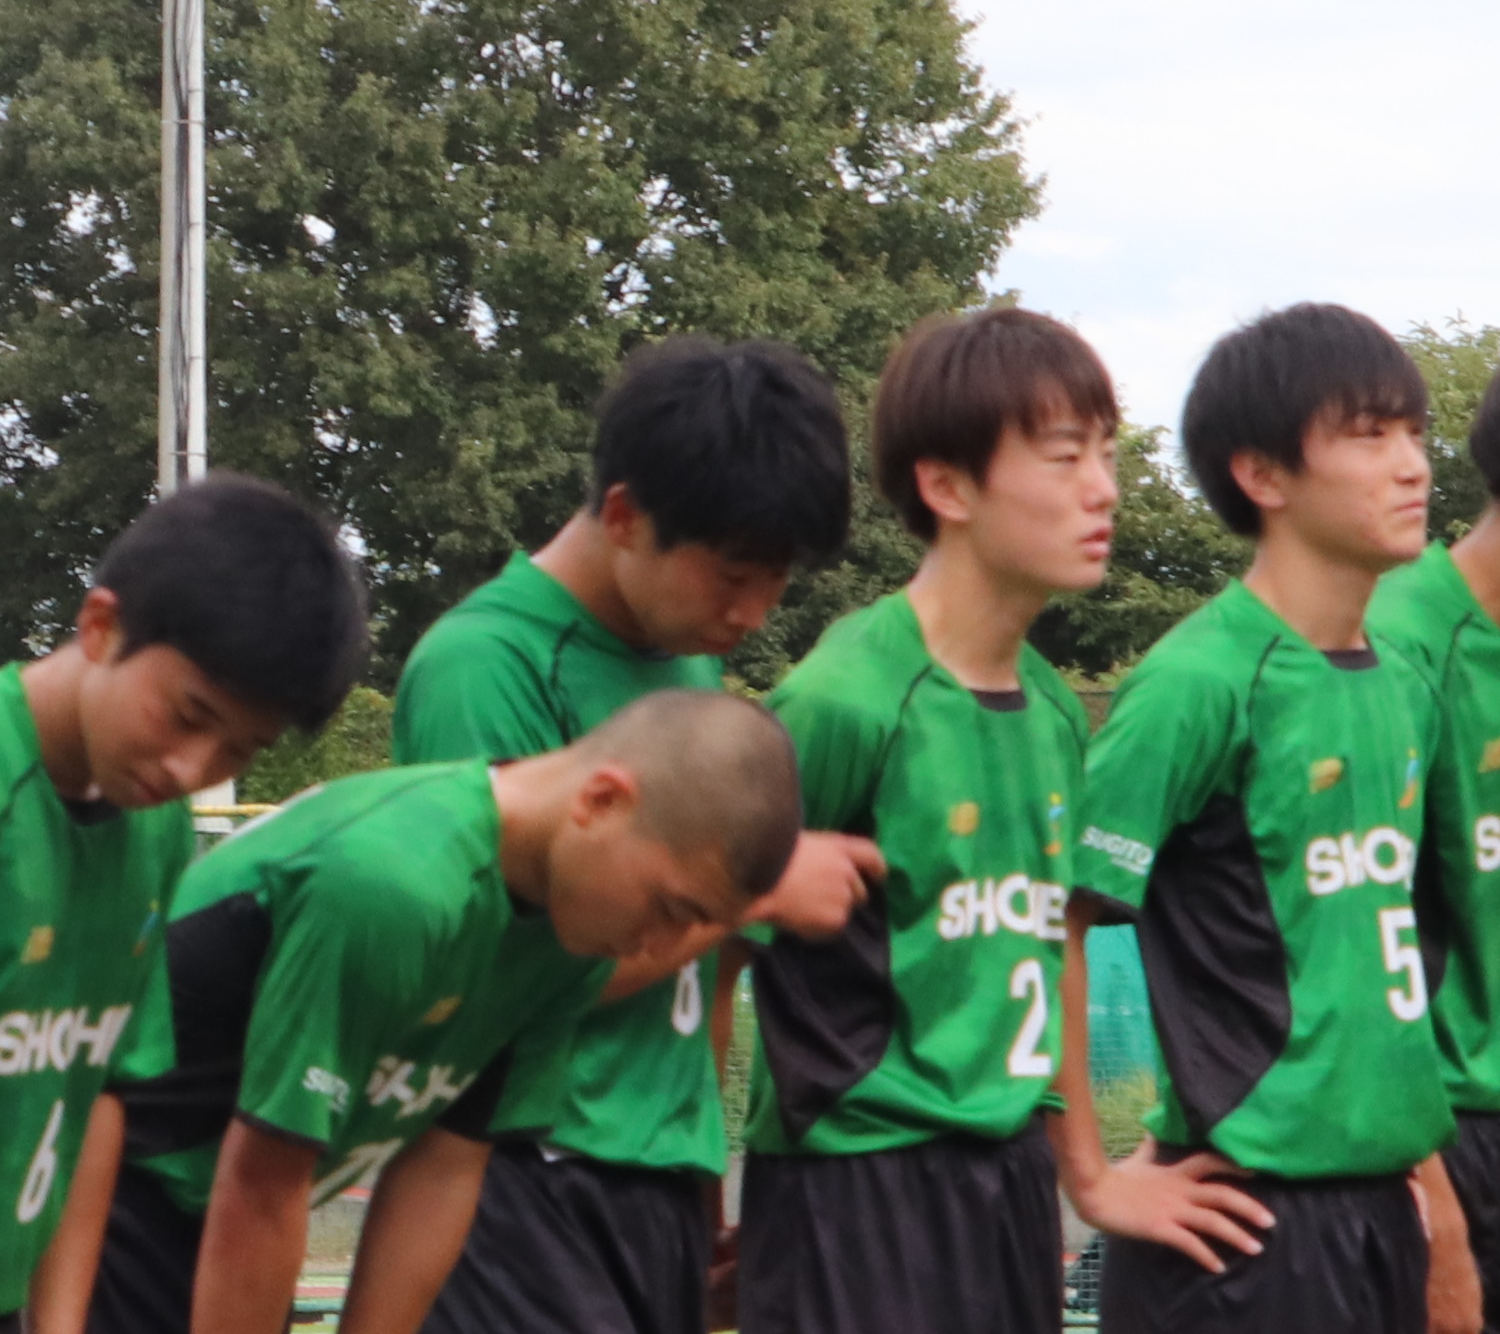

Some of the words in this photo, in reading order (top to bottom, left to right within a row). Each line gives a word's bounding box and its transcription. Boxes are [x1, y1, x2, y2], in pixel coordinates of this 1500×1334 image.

[1007, 957, 1055, 1078] 2
[1377, 905, 1428, 1022] 5
[15, 1099, 64, 1224] 6
